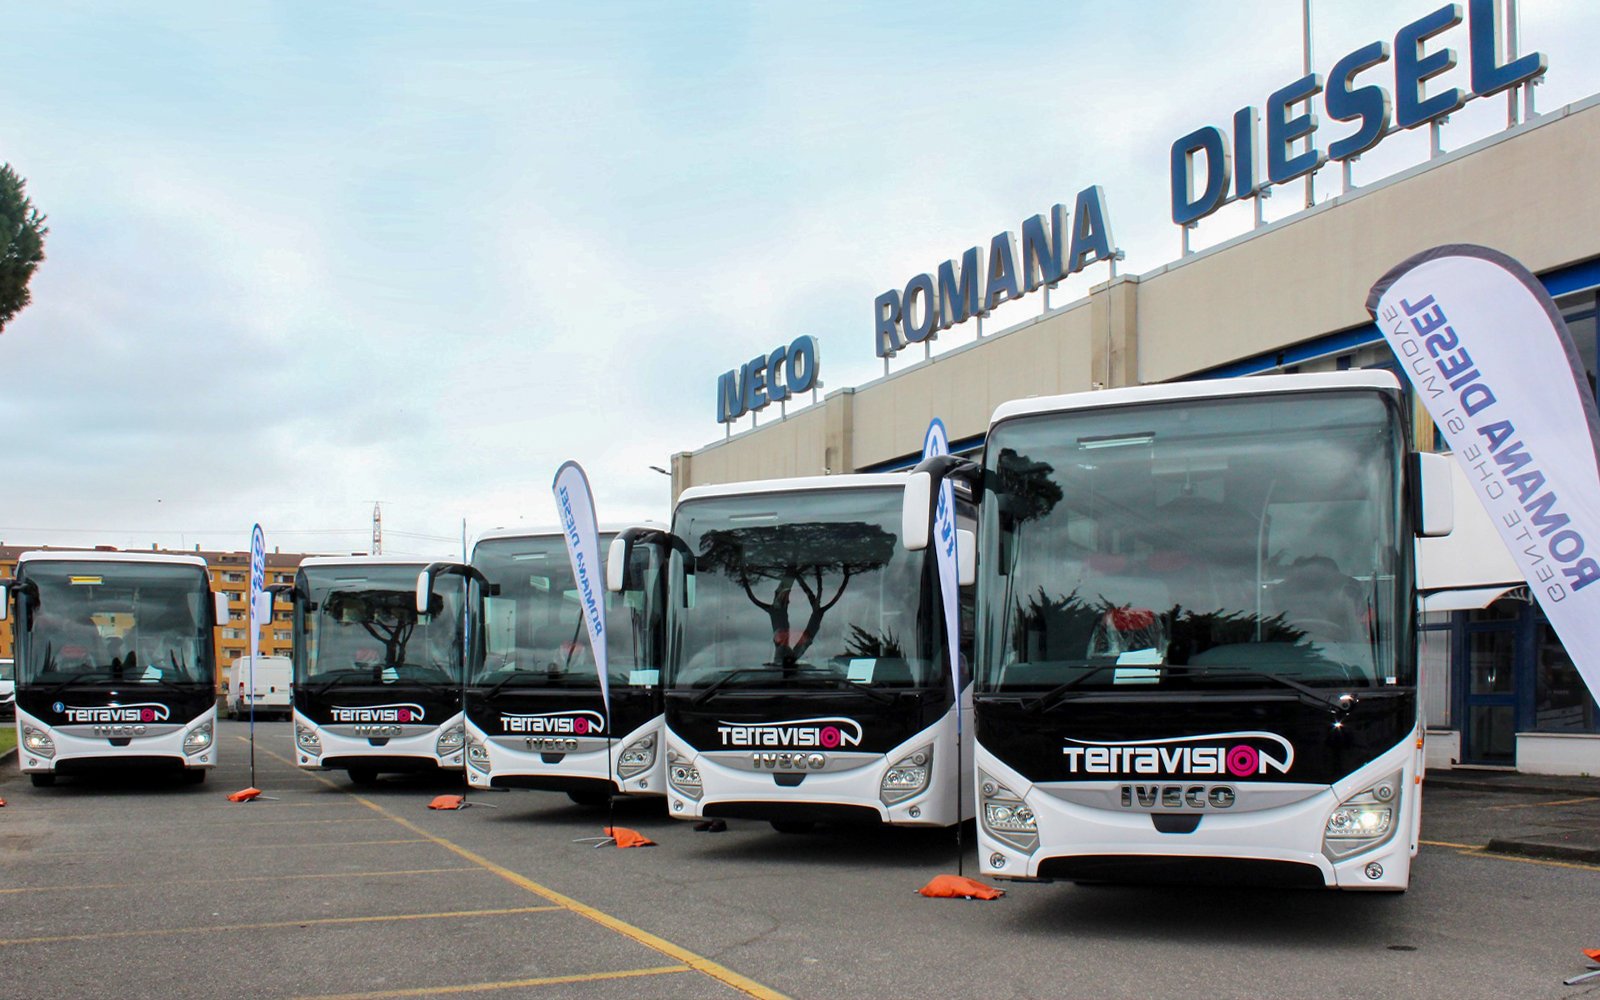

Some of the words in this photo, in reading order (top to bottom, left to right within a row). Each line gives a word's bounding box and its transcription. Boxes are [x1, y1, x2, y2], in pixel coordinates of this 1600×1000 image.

[717, 335, 819, 423] IVECO
[875, 185, 1116, 358] ROMANA
[1171, 0, 1548, 225] DIESEL
[354, 725, 402, 735] IVECO
[526, 737, 578, 750] IVECO
[753, 753, 825, 769] IVECO
[1120, 785, 1236, 808] IVECO
